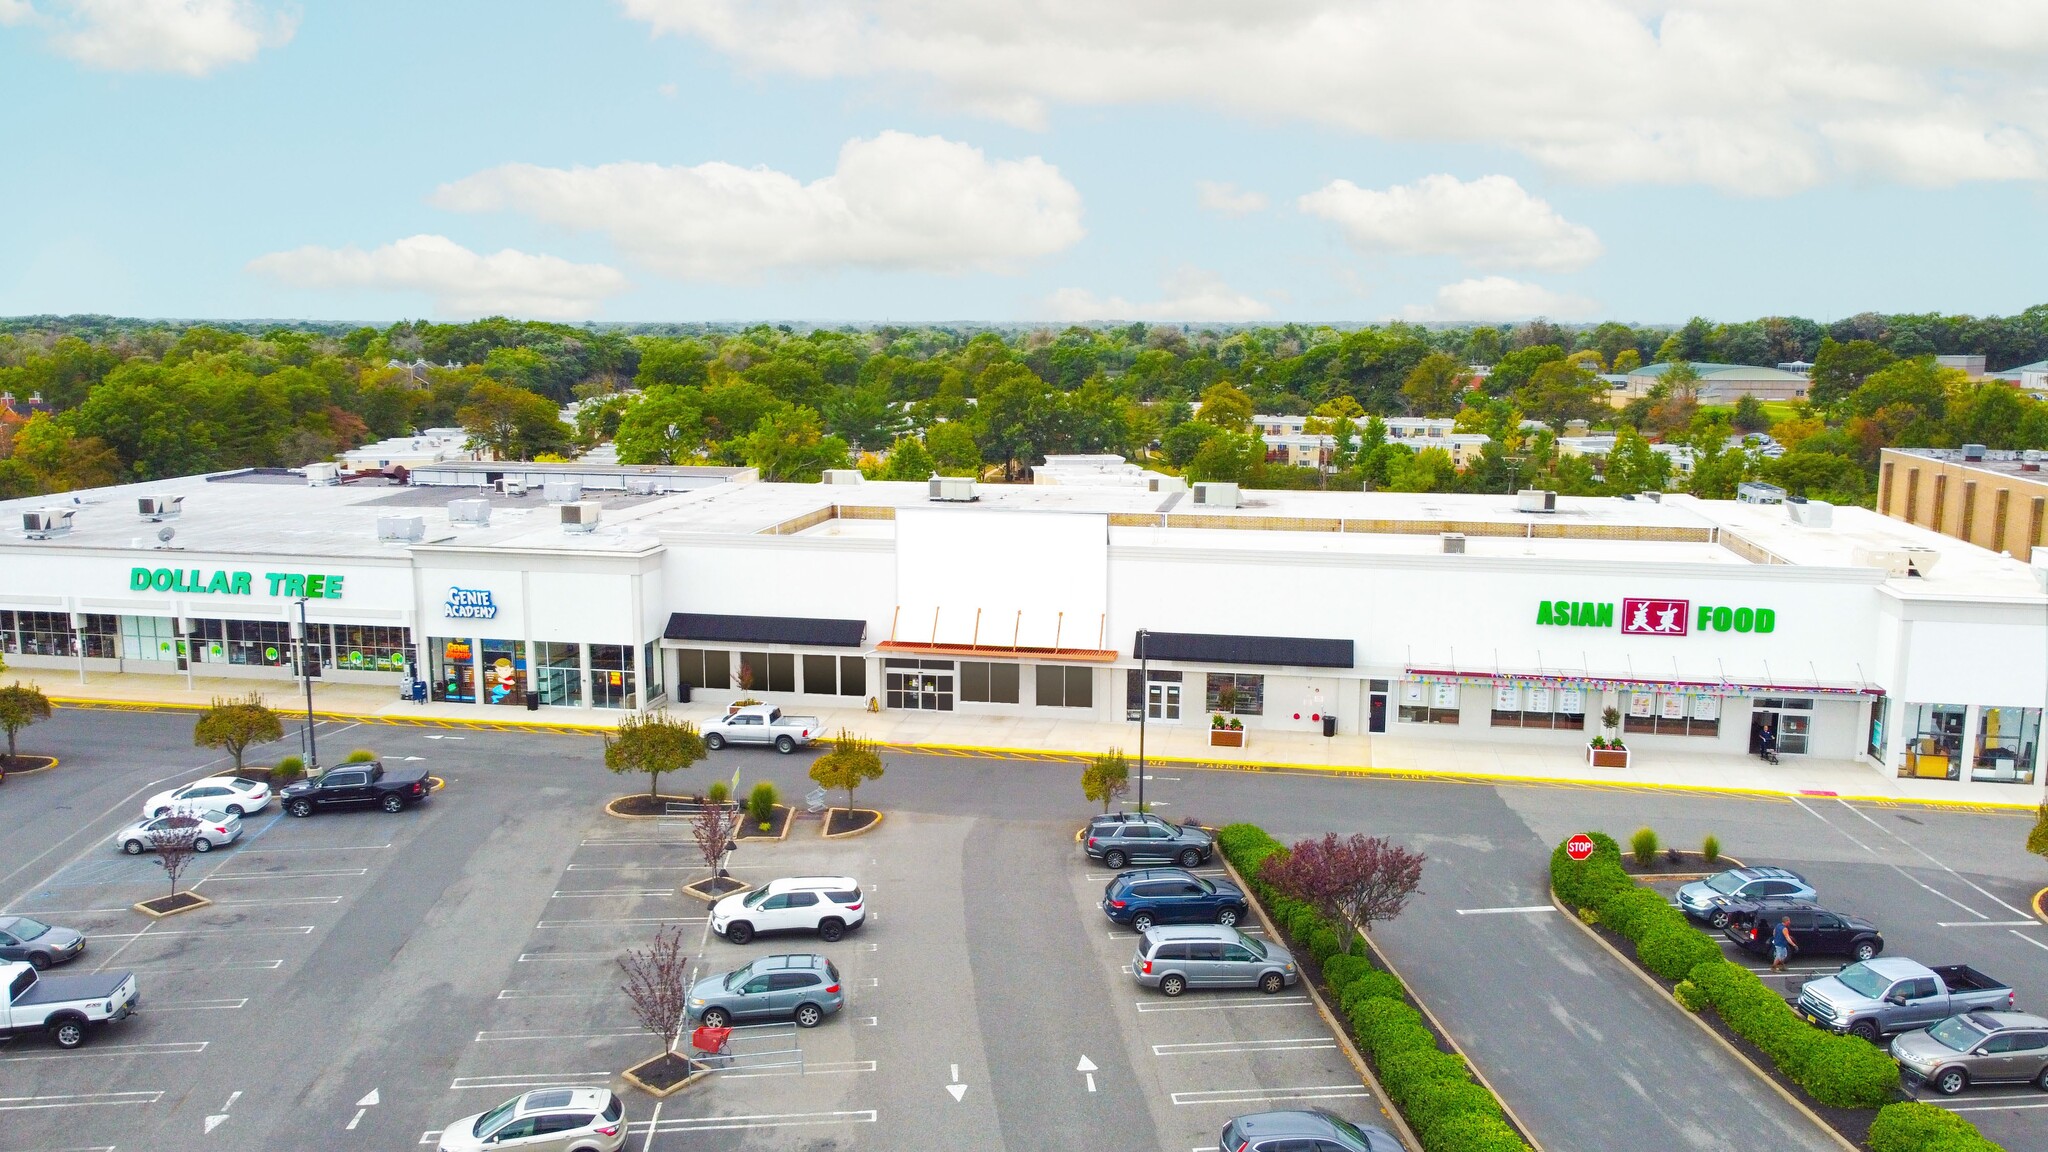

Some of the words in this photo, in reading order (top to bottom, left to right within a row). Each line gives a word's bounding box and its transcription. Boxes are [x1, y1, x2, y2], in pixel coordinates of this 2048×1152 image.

[130, 567, 252, 595] DOLLAR
[265, 572, 344, 599] TREE
[448, 587, 490, 605] GENIE
[444, 603, 496, 618] ACADEMY
[1536, 600, 1614, 627] ASIAN
[1697, 606, 1776, 633] FOOD
[1196, 763, 1261, 771] PARKING
[1568, 842, 1591, 852] STOP
